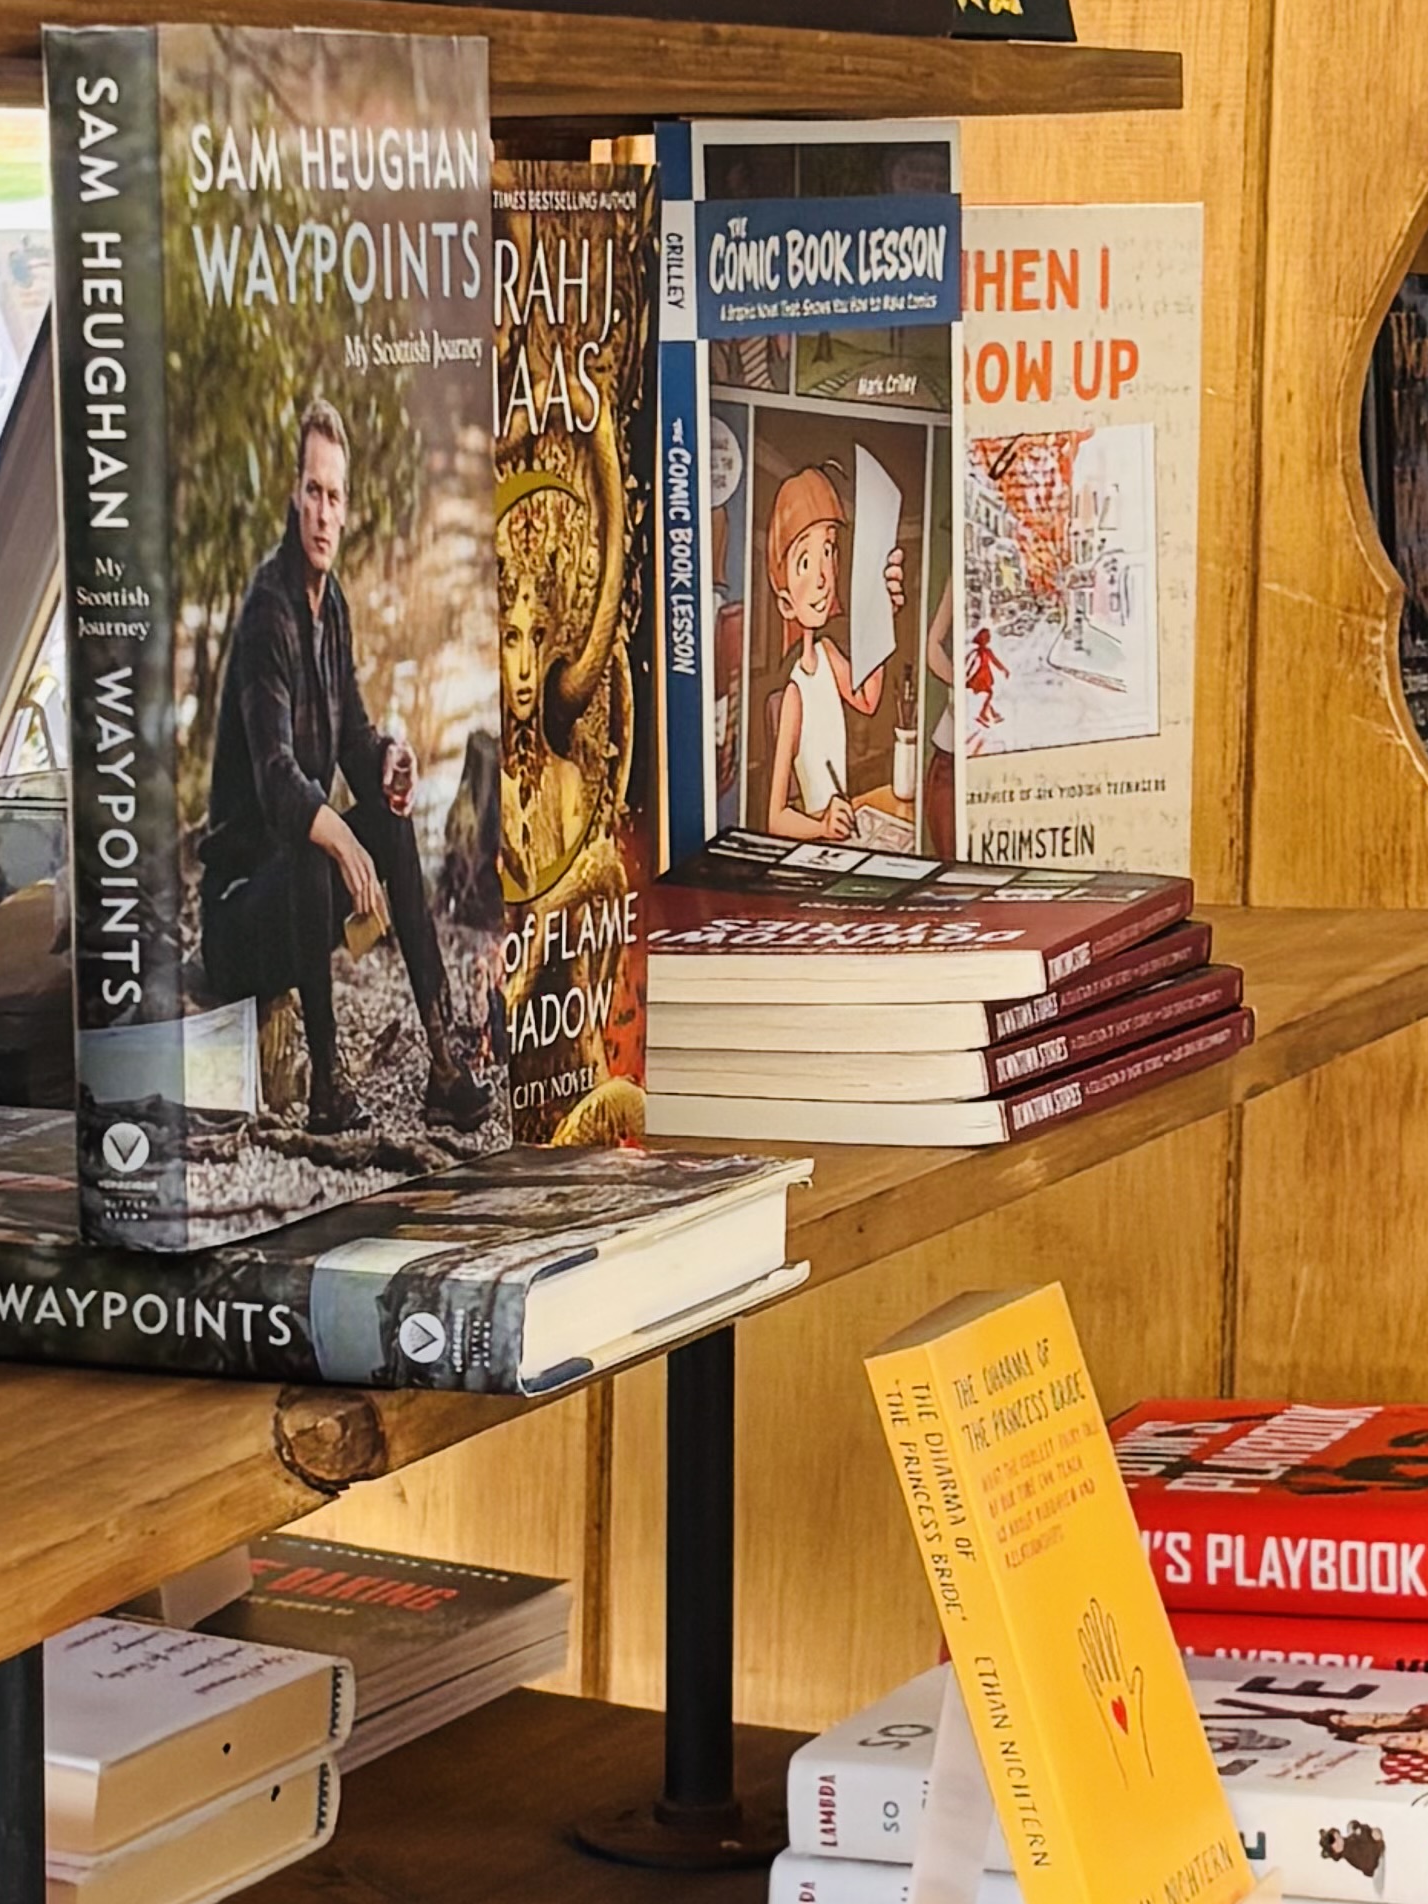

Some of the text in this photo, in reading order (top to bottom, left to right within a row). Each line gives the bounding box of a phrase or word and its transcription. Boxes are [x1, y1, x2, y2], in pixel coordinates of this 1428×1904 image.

[191, 124, 480, 194] SAM HEUGHAN
[528, 190, 597, 212] BESTSELLING
[728, 217, 748, 238] THE
[193, 220, 483, 308] WAYPOINTS
[601, 240, 621, 342] J.
[666, 233, 685, 310] CRILLEY
[708, 225, 947, 295] COMIC BOOK LESSON
[1100, 243, 1110, 312] I
[77, 77, 130, 529] SAM HEUGHAN
[345, 332, 484, 369] My Scottish Journey
[1073, 338, 1139, 402] UP
[94, 558, 126, 582] My
[668, 447, 696, 676] COMIC BOOK LESSON
[76, 586, 151, 610] Scottish
[78, 618, 151, 642] Journey
[92, 665, 143, 1008] WAYPOINTS
[982, 822, 1096, 865] KRIMSTEIN
[504, 892, 639, 974] of FLAME
[514, 1064, 597, 1110] CITY NOVEL
[953, 1349, 1034, 1411] THE DHARMA
[899, 1441, 943, 1544] PRINCESS
[912, 1381, 977, 1563] THE DHARMA OF
[1205, 1532, 1428, 1597] PLAYBOOK
[974, 1656, 1052, 1868] ETHAN NICHTERN
[819, 1774, 839, 1848] LAMBDA
[883, 1801, 900, 1834] SO
